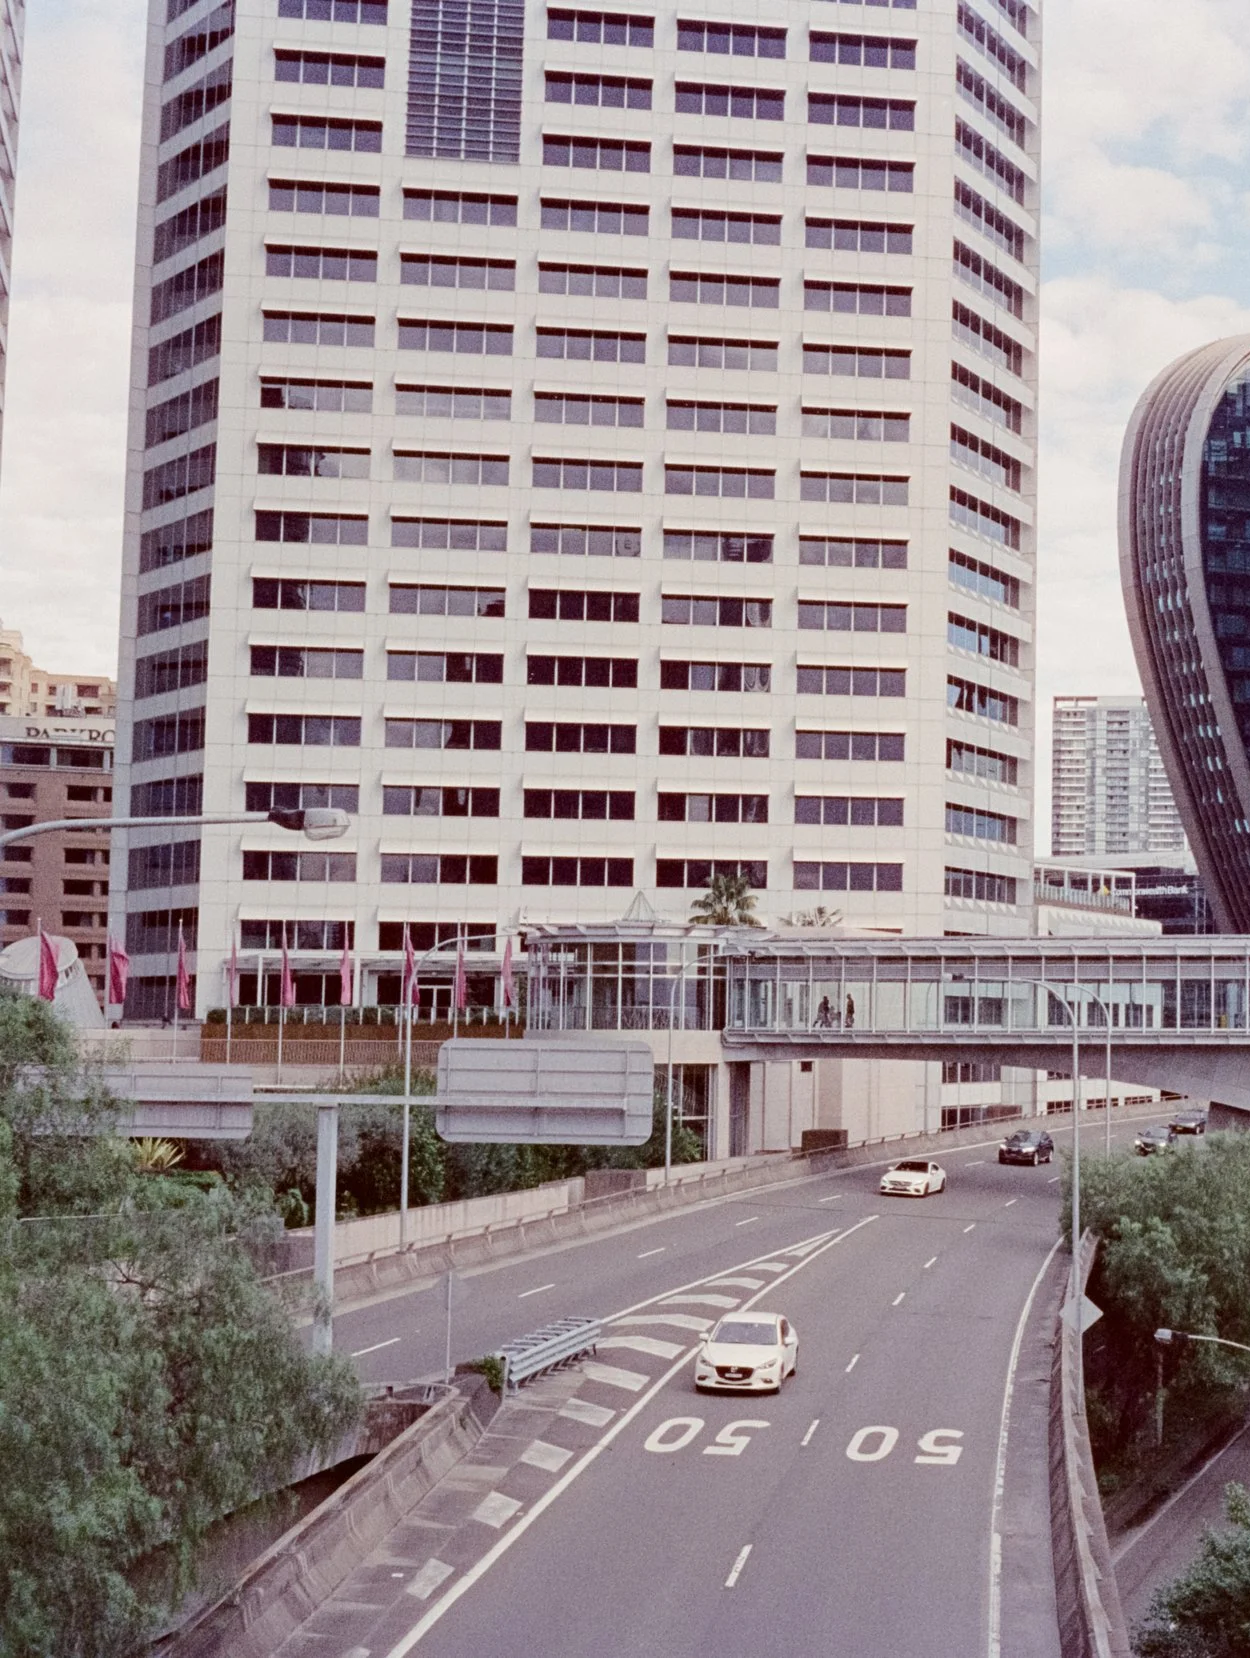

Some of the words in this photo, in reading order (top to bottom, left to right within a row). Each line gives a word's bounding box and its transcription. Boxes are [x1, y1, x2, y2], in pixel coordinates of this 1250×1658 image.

[25, 726, 115, 742] PARO
[644, 1417, 771, 1455] 50
[846, 1425, 964, 1465] 50
